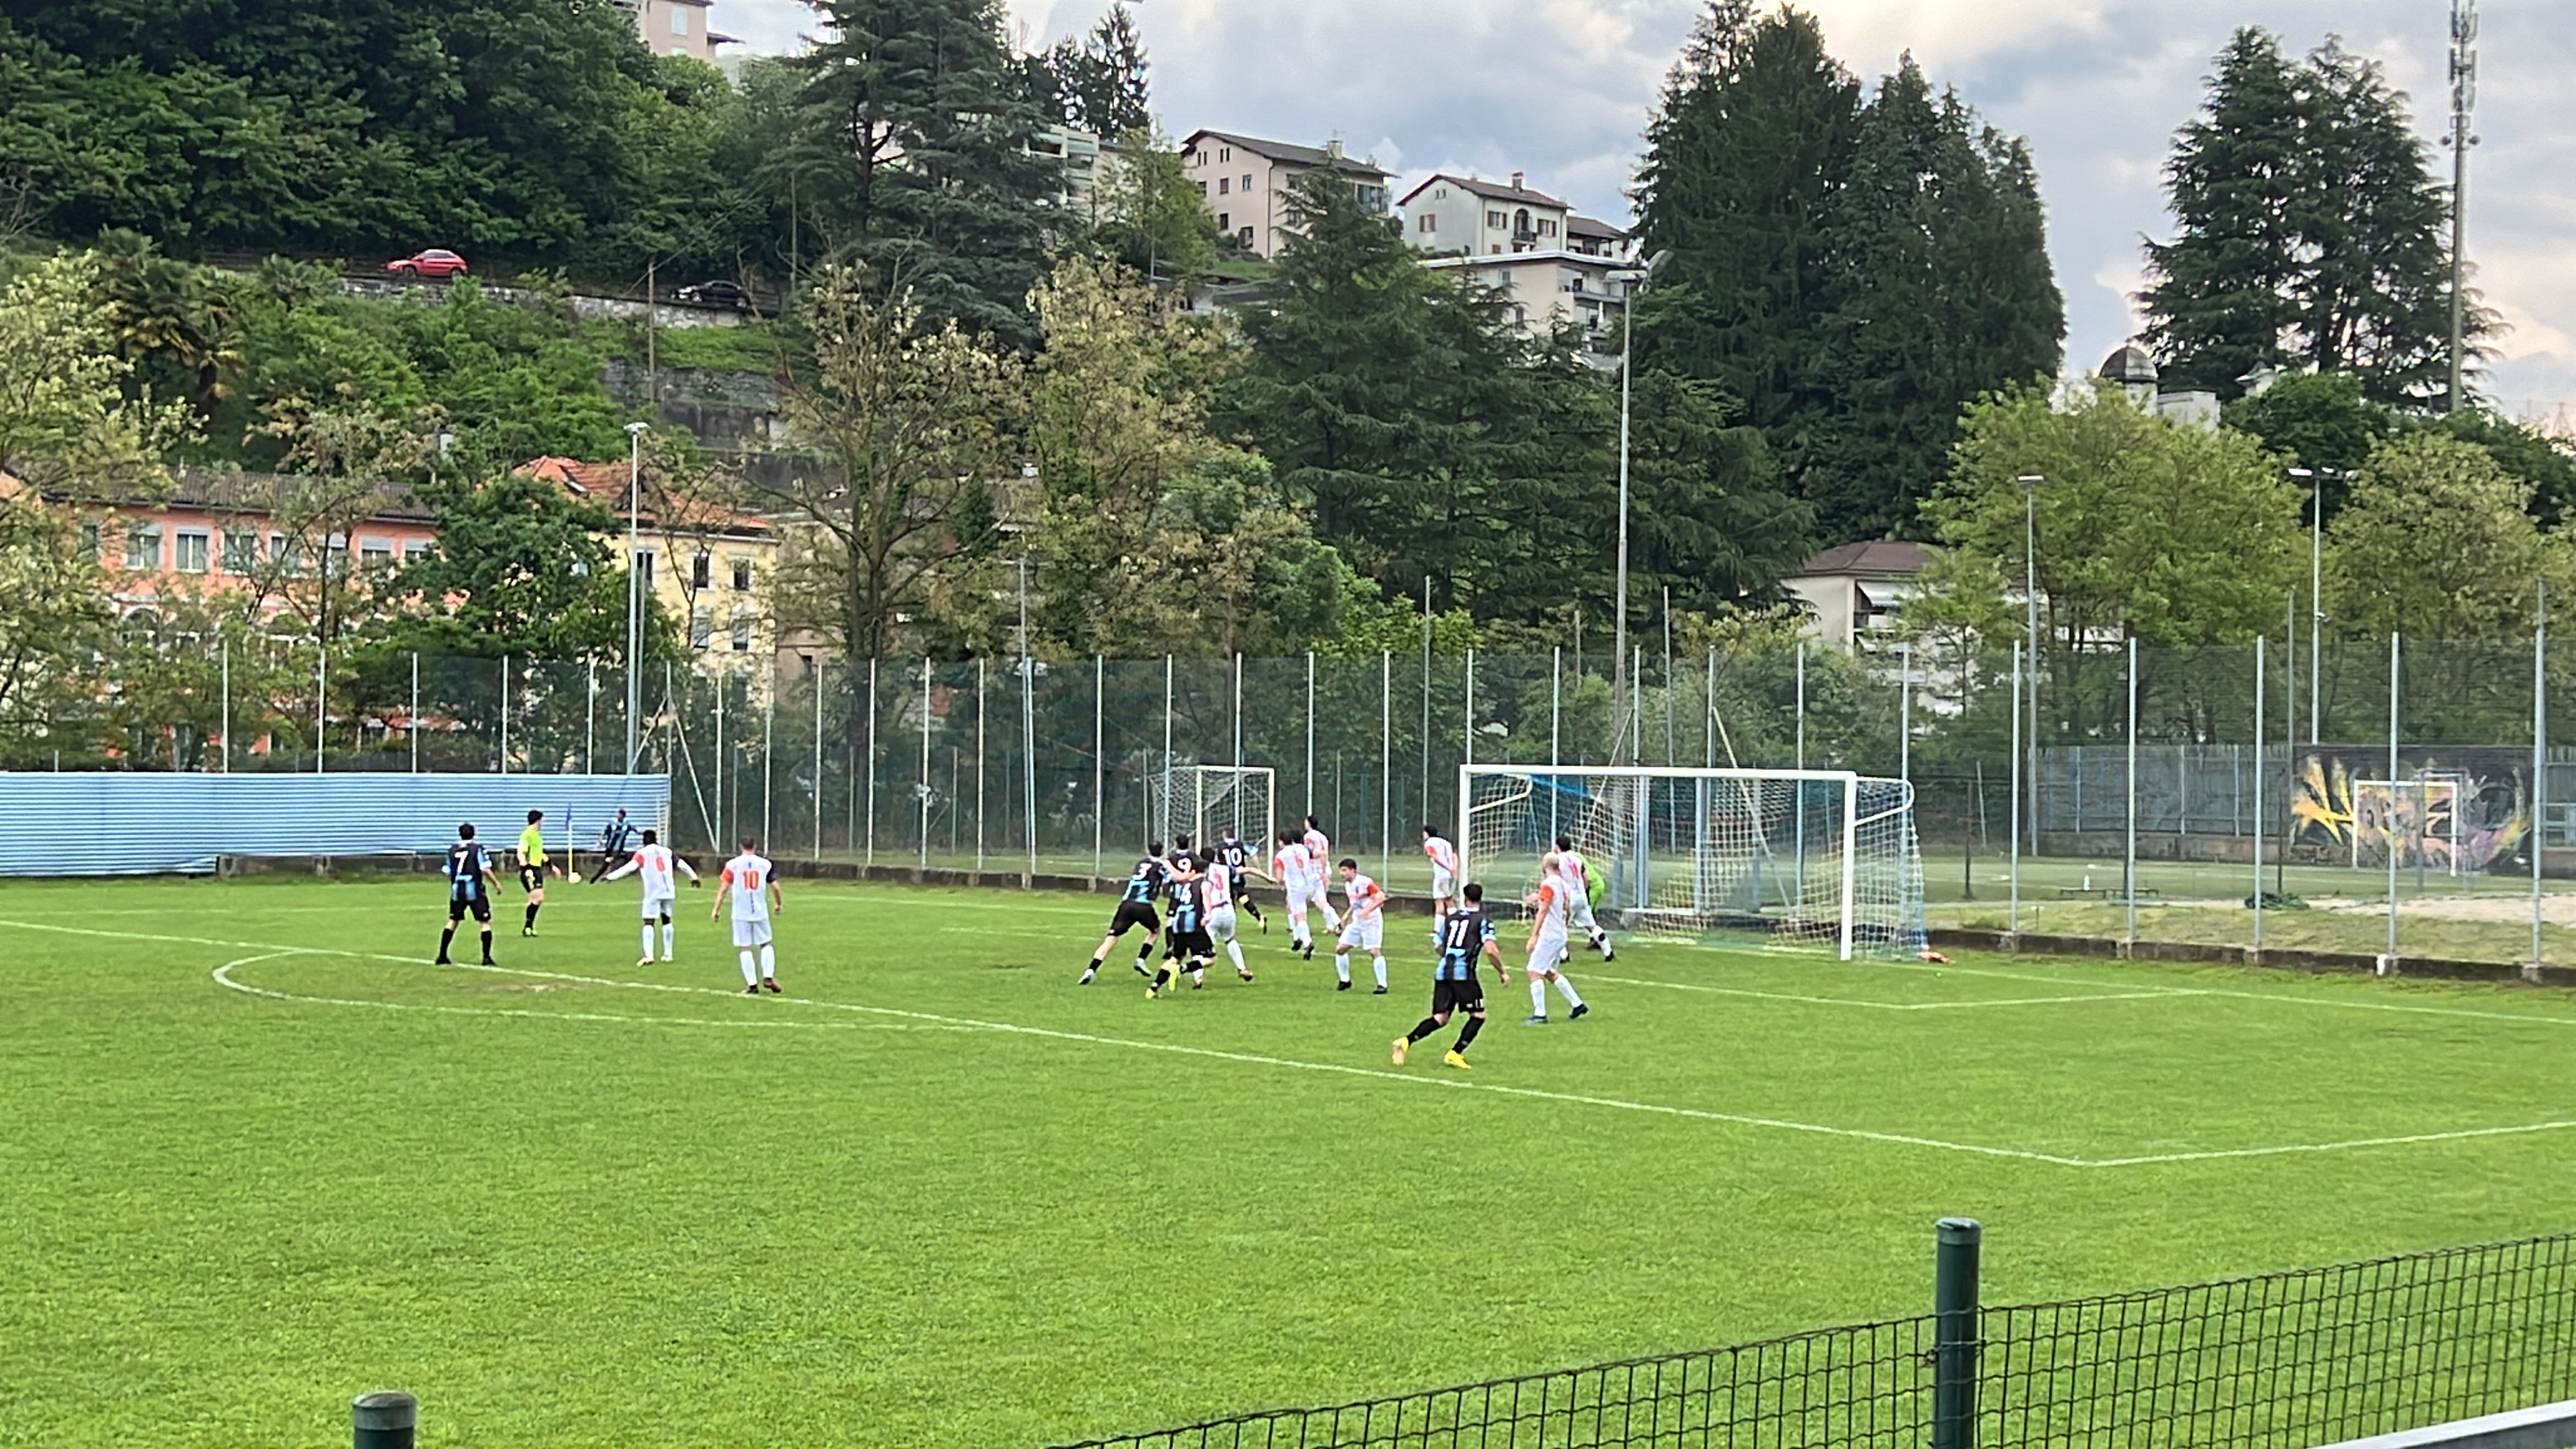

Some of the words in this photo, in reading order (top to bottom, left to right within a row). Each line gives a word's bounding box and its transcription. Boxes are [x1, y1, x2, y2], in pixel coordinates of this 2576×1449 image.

[454, 850, 468, 874] 7
[1177, 858, 1192, 874] 9
[1222, 847, 1242, 866] 10
[742, 870, 759, 890] 10
[1132, 863, 1152, 880] 3
[1213, 872, 1224, 891] 3
[1447, 919, 1469, 948] 11
